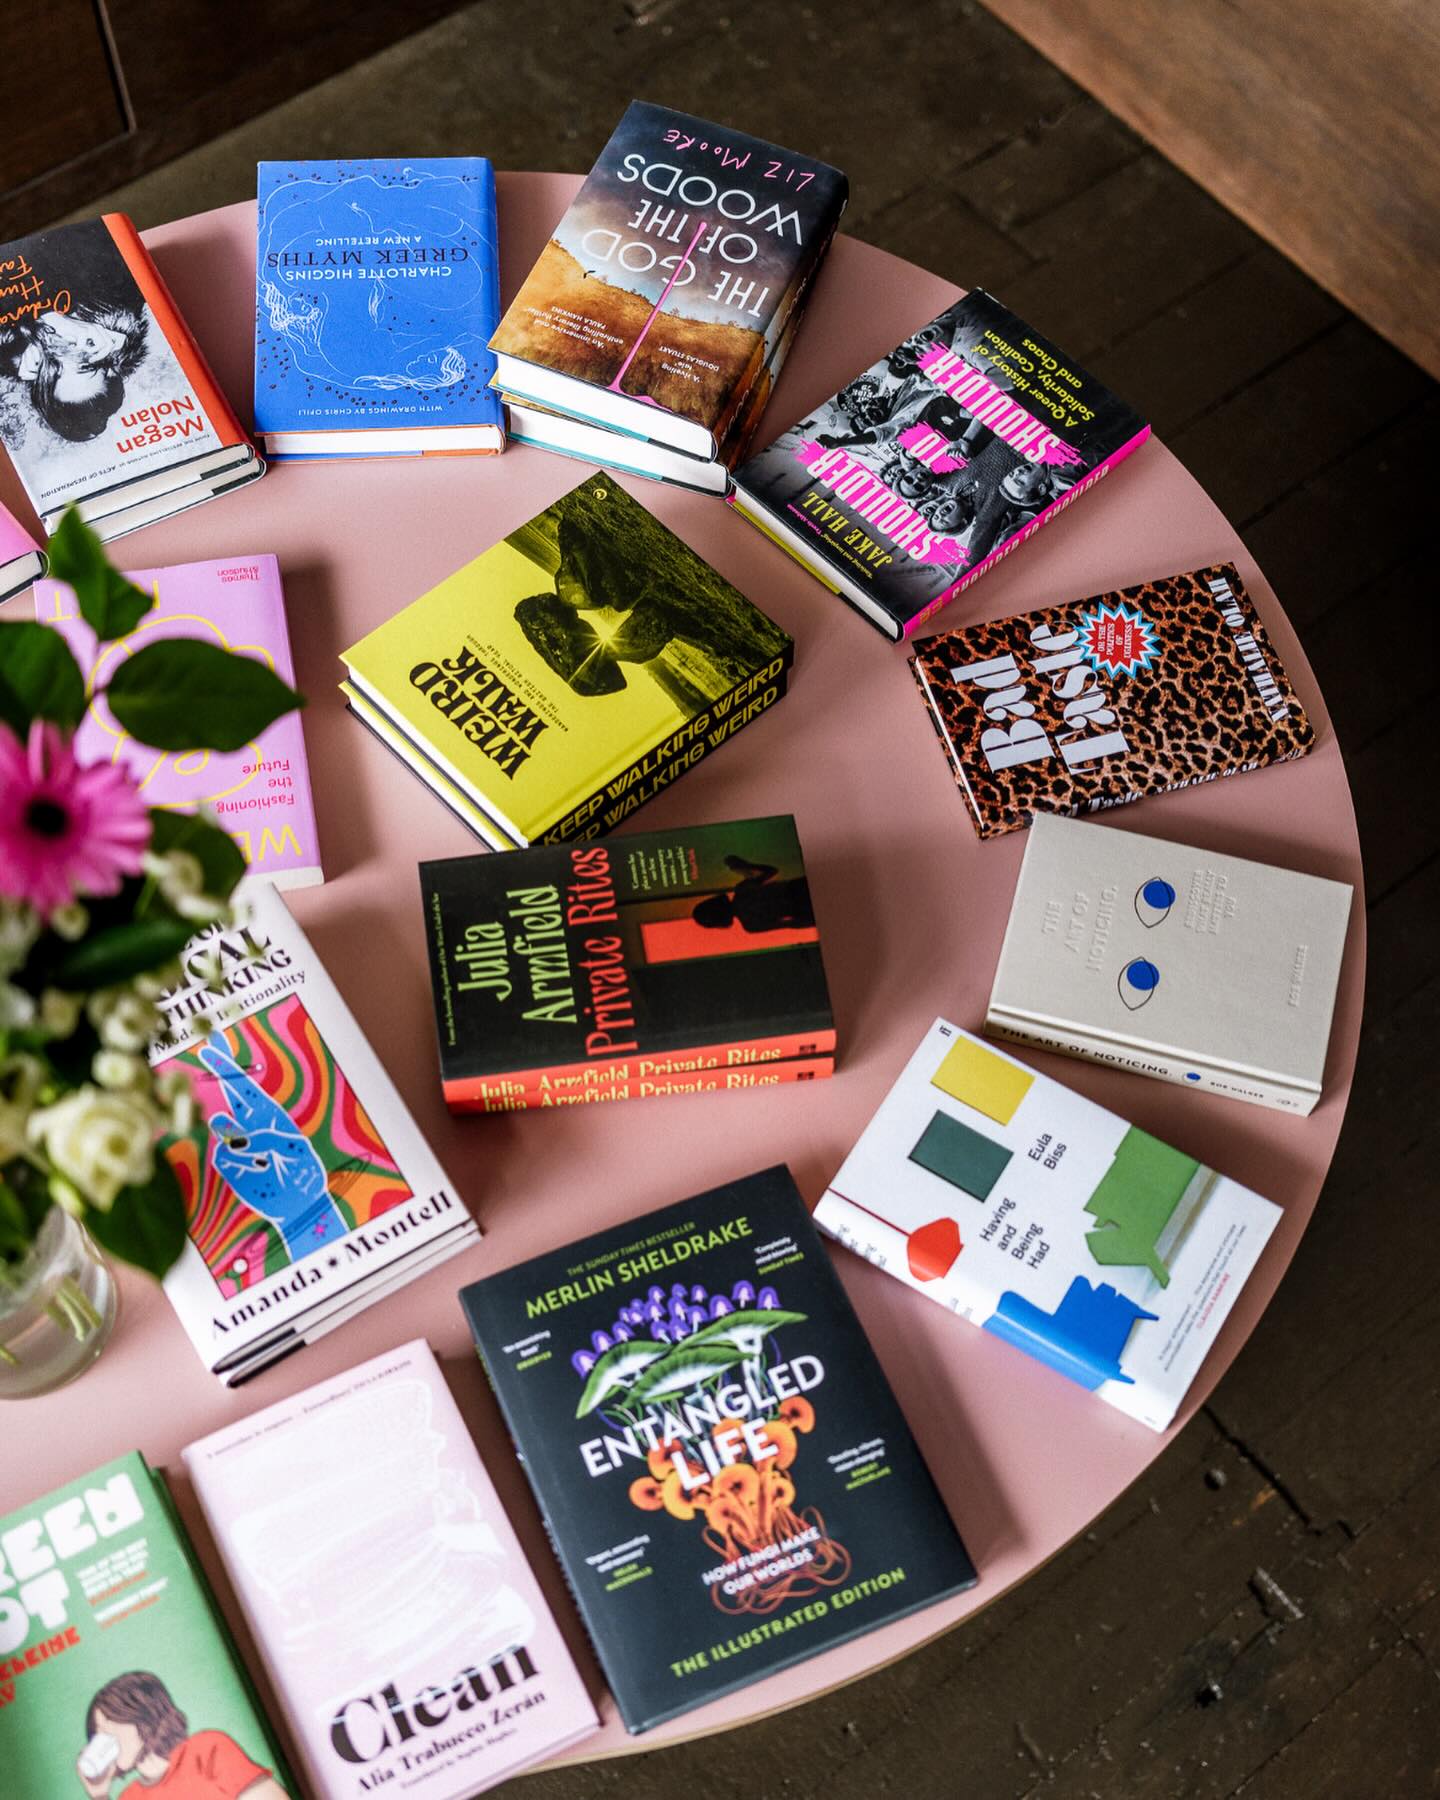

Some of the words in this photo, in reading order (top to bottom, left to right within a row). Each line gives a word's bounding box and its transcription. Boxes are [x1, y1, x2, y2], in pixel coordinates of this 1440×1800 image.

[759, 157, 816, 195] LIZ
[613, 146, 815, 250] WOODS
[626, 195, 692, 245] THE
[315, 236, 379, 246] RETELLING
[374, 246, 468, 264] GREEK
[382, 235, 412, 244] NEW
[413, 235, 421, 243] A
[696, 220, 762, 271] OF
[266, 249, 362, 268] MYTHS
[285, 268, 352, 280] HIGGINS
[358, 265, 451, 278] CHARLOTTE
[575, 219, 700, 297] GOD
[706, 267, 772, 319] THE
[549, 302, 583, 324] HAWKINS
[550, 313, 582, 332] literary
[582, 315, 606, 331] PAULA
[549, 322, 591, 344] immersive
[580, 323, 624, 346] enthralling
[970, 341, 991, 359] of
[657, 342, 685, 360] STUART
[684, 351, 720, 374] DOUGLAS
[979, 327, 1037, 375] Coalition
[1018, 336, 1061, 372] Chaos
[660, 362, 691, 378] riveting
[984, 351, 1034, 391] History
[1054, 366, 1085, 391] and
[297, 408, 321, 416] OFILI
[324, 407, 351, 415] CHRIS
[354, 406, 365, 414] BY
[368, 405, 415, 413] DRAWINGS
[418, 404, 442, 412] WITH
[920, 347, 1063, 467] SHOULDER
[1025, 385, 1068, 420] Queer
[1029, 367, 1098, 424] Solidarity,
[119, 394, 196, 433] Nolan
[1061, 415, 1079, 430] A
[115, 414, 206, 453] Megan
[906, 429, 954, 468] TO
[97, 465, 117, 475] ACTS
[798, 489, 850, 534] HALL
[803, 442, 946, 566] SHOULDER
[842, 526, 894, 571] JAKE
[216, 564, 259, 577] &Hudson
[219, 571, 260, 583] Thames
[1206, 575, 1247, 629] OLAH
[464, 633, 490, 656] THROUGH
[485, 643, 502, 658] YEAR
[1106, 622, 1114, 655] POLITICS
[1116, 634, 1121, 645] OF
[489, 656, 524, 689] WONDERINGS
[501, 658, 524, 678] RITUAL
[1231, 629, 1292, 723] NATHALIE
[439, 644, 553, 750] WALK
[522, 678, 548, 702] BRITISH
[546, 701, 560, 713] THE
[1012, 615, 1134, 777] Taste
[403, 656, 536, 781] WEIRD
[534, 699, 570, 733] WANDERINGS
[948, 651, 1056, 776] Bad
[240, 758, 290, 776] Future
[541, 792, 603, 852] KEEP
[604, 710, 709, 797] WALKING
[710, 655, 781, 718] WEIRD
[602, 740, 702, 824] WALKING
[705, 684, 775, 745] WEIRD
[266, 776, 292, 790] the
[214, 791, 295, 815] Fashioning
[557, 844, 620, 925] Rites
[1040, 899, 1063, 936] THE
[449, 919, 514, 1006] Julia
[504, 882, 578, 1029] Armfield
[570, 933, 639, 1056] Private
[999, 1026, 1034, 1042] THE
[1035, 1035, 1066, 1050] ART
[1067, 1043, 1089, 1056] OF
[1092, 1049, 1173, 1078] NOTICING.
[471, 1077, 525, 1101] Julia
[536, 1059, 631, 1093] Armfield
[637, 1049, 720, 1078] Private
[725, 1041, 782, 1065] Rites
[482, 1093, 527, 1115] Julia
[538, 1081, 630, 1111] Armfield
[638, 1071, 719, 1100] Private
[725, 1066, 780, 1091] Rites
[1209, 1079, 1228, 1090] ROB
[1230, 1085, 1264, 1099] WALKER
[1026, 1129, 1053, 1162] Eula
[1041, 1139, 1068, 1171] Biss
[977, 1194, 1017, 1245] Having
[993, 1222, 1018, 1252] and
[565, 1262, 586, 1277] THE
[584, 1249, 620, 1270] SUNDAY
[618, 1239, 645, 1256] TIMES
[644, 1219, 696, 1246] BESTSELLER
[1009, 1219, 1044, 1263] Being
[1024, 1238, 1051, 1270] Had
[208, 1260, 324, 1342] Amanda
[340, 1188, 454, 1265] Montell
[522, 1269, 615, 1320] MERLIN
[616, 1215, 754, 1283] SHELDRAKE
[757, 1258, 784, 1276] SUNDAY
[781, 1250, 805, 1266] TIMES
[577, 1349, 830, 1479] ENTANGLED
[668, 1415, 780, 1493] LIFE
[700, 1559, 740, 1586] HOW
[736, 1542, 782, 1572] FUNGI
[778, 1525, 821, 1554] MAKE
[721, 1570, 758, 1597] OUR
[753, 1546, 815, 1583] WORLDS
[668, 1649, 710, 1679] THE
[708, 1598, 830, 1662] ILLUSTRATED
[828, 1565, 908, 1611] EDITION
[328, 1640, 541, 1765] Clean
[354, 1762, 396, 1795] Alia
[396, 1716, 489, 1773] Trabucco
[487, 1689, 546, 1727] Zerán
